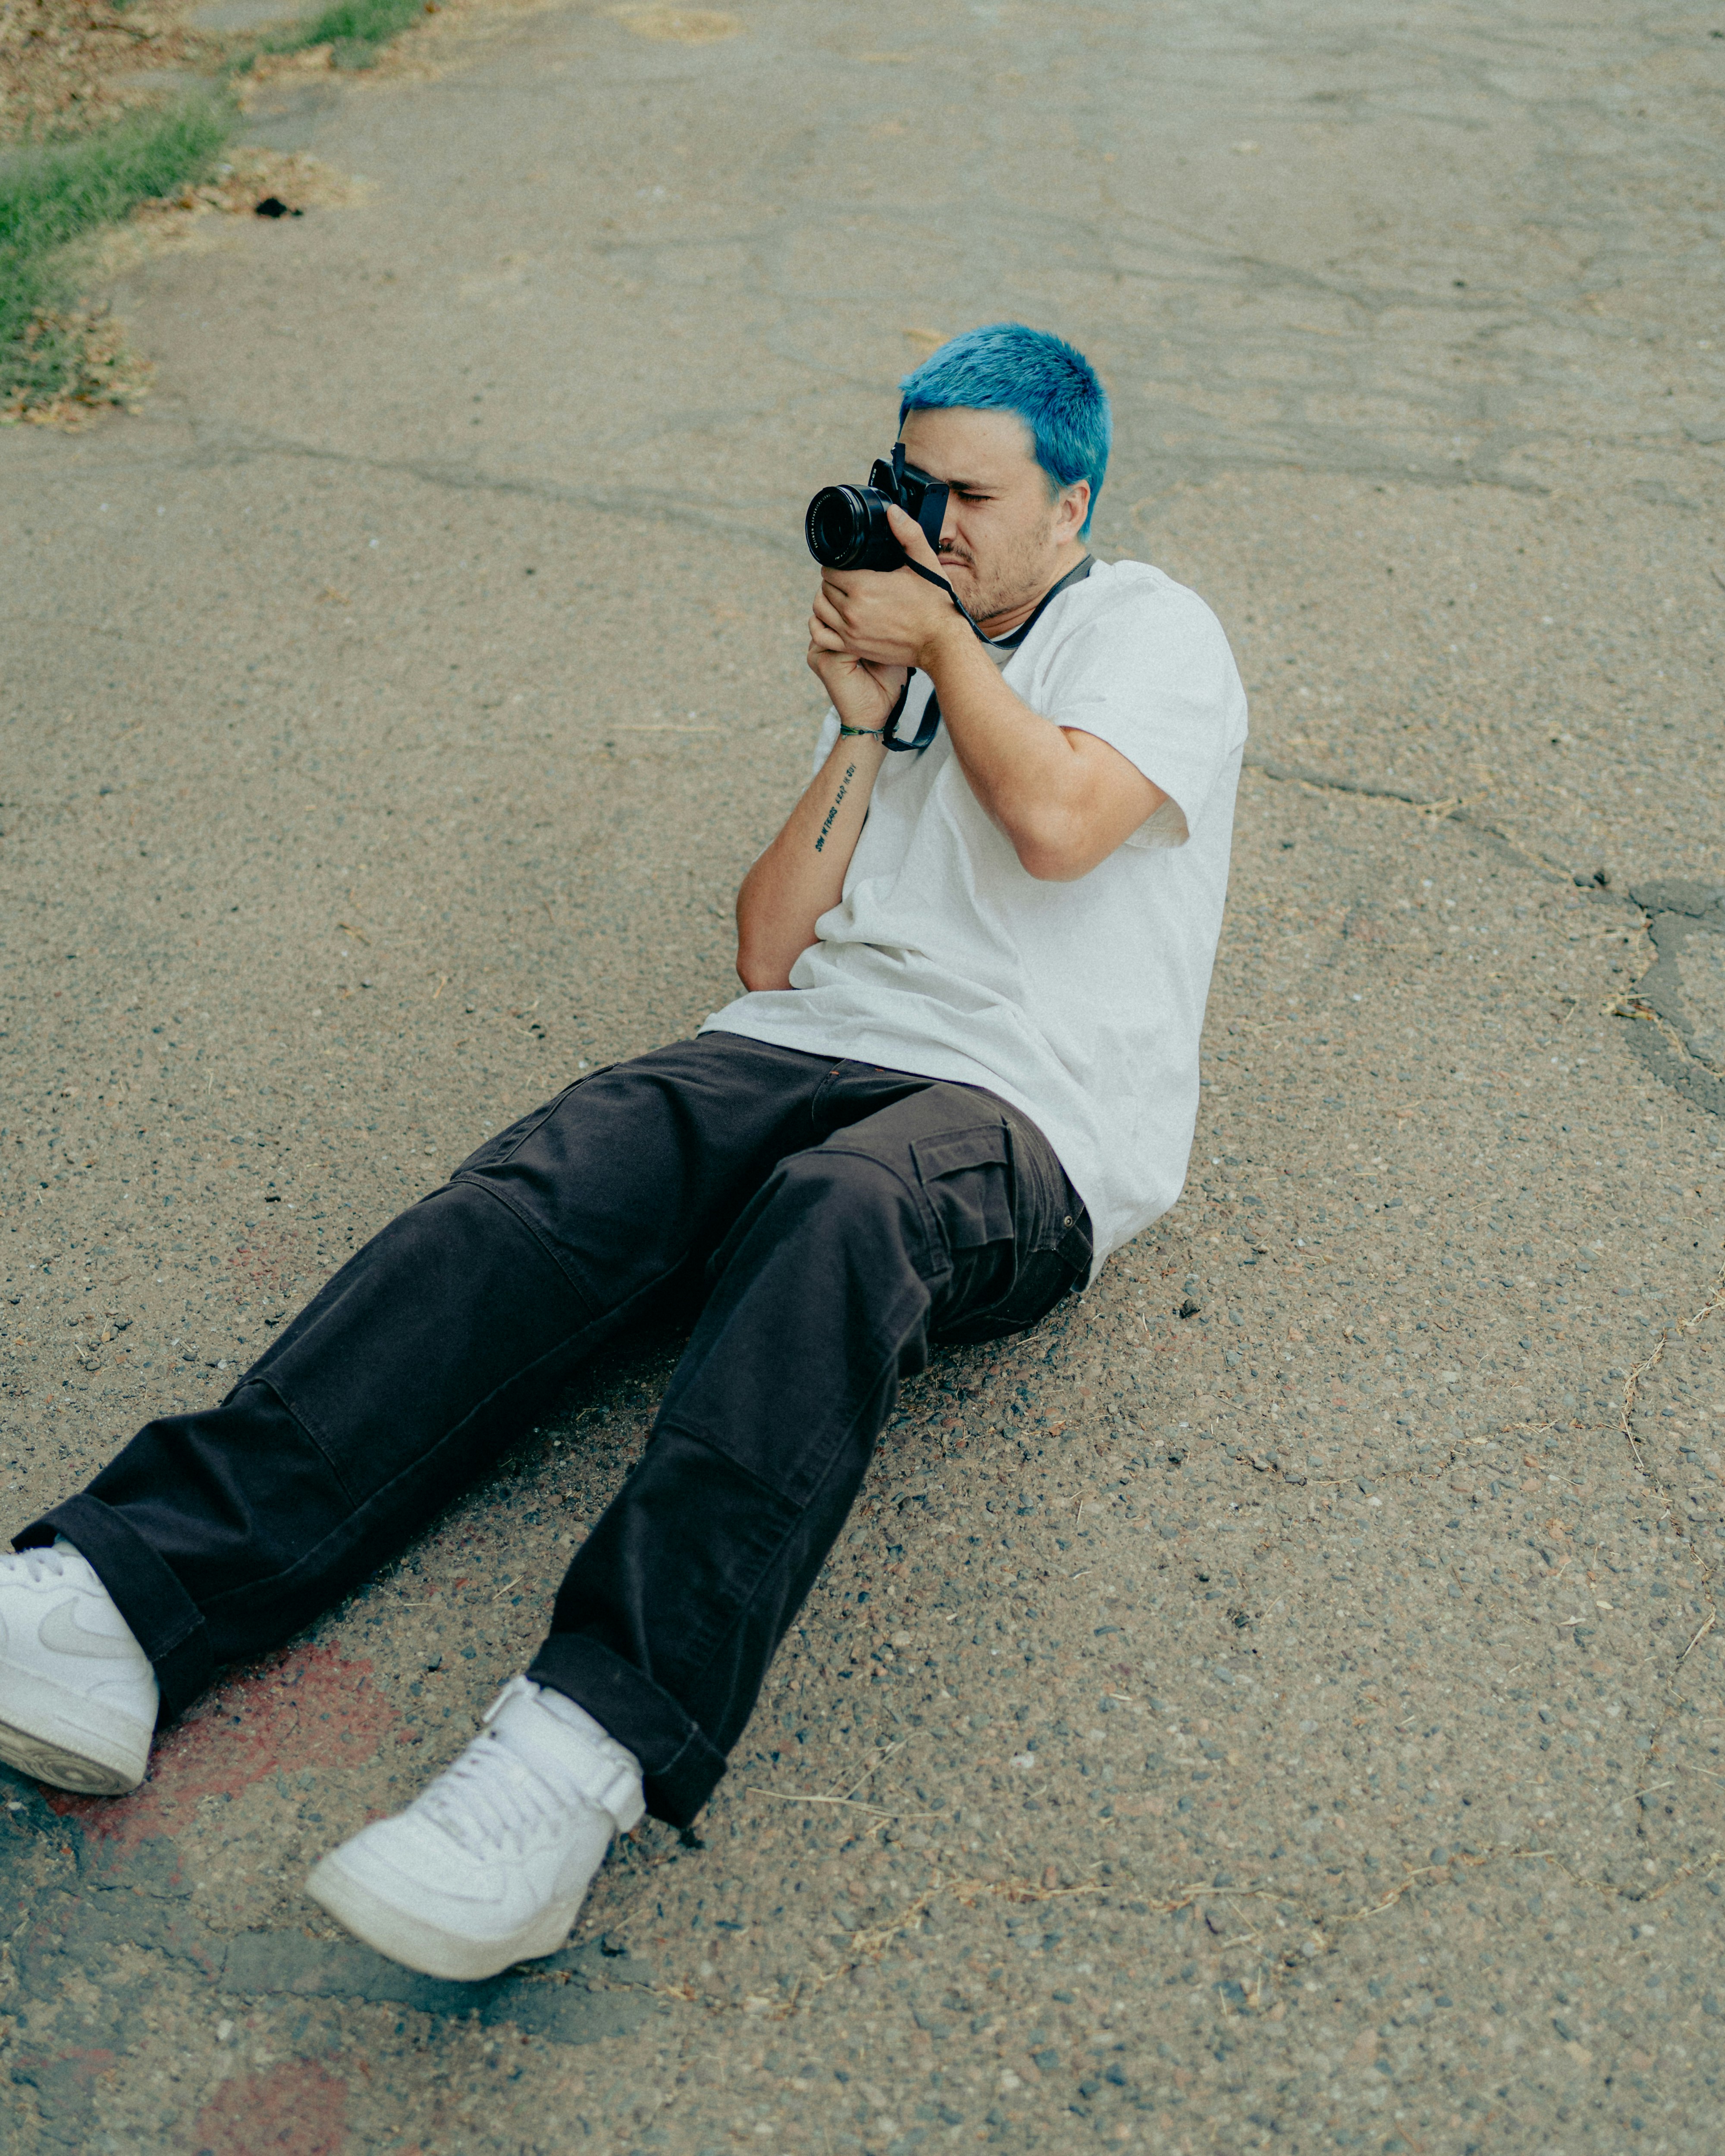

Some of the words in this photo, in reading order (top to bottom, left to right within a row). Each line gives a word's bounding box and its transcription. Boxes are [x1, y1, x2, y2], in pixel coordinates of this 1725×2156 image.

[811, 500, 822, 526] ASPHERICAL
[846, 762, 856, 777] JOY
[843, 777, 850, 785] IN
[835, 785, 847, 805] REAP
[824, 806, 837, 829] TEARS
[822, 827, 828, 837] IN
[815, 836, 825, 852] SOW
